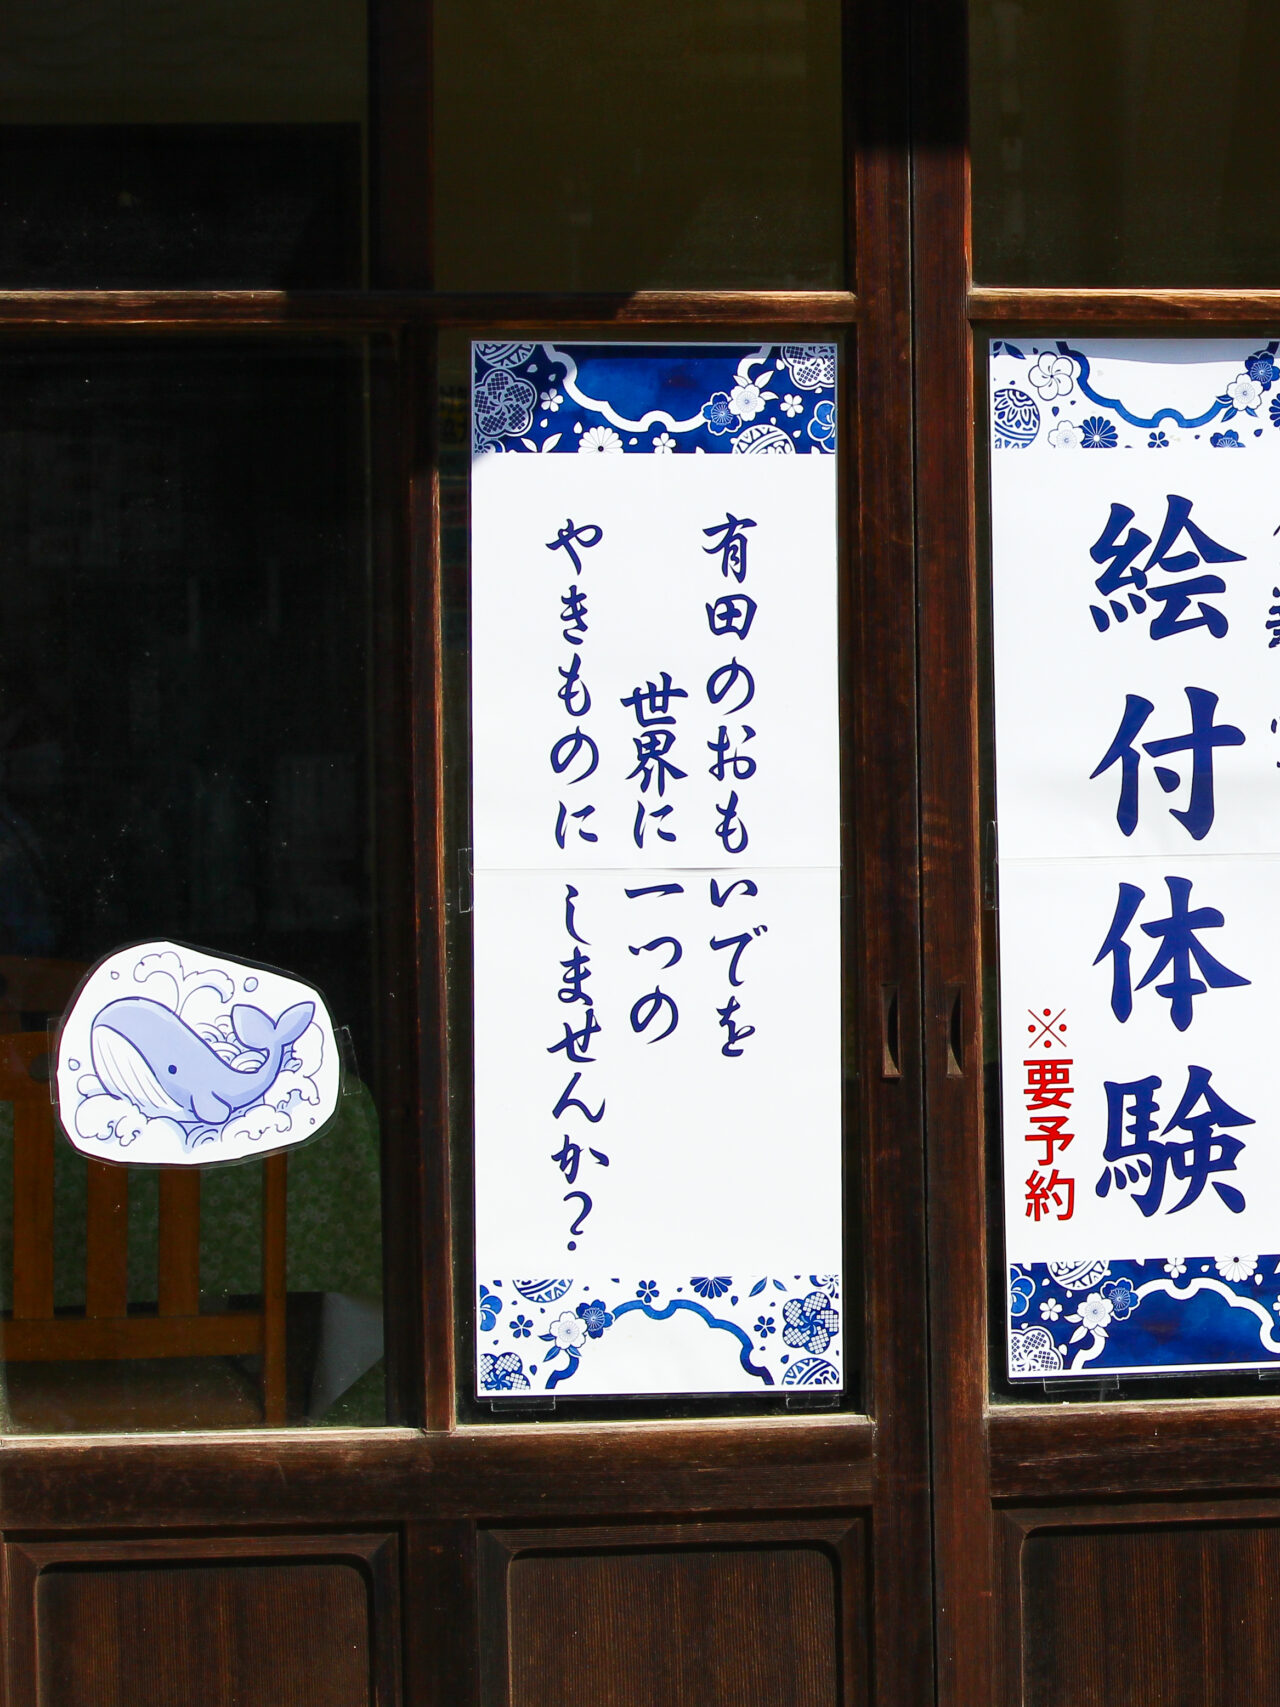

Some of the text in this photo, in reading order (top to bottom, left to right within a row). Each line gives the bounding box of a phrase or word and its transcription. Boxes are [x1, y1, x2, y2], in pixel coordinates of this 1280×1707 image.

[620, 672, 688, 1044] 世界に一つの
[703, 512, 767, 1057] 有田のおもいでを
[1089, 494, 1256, 1217] 絵付体験
